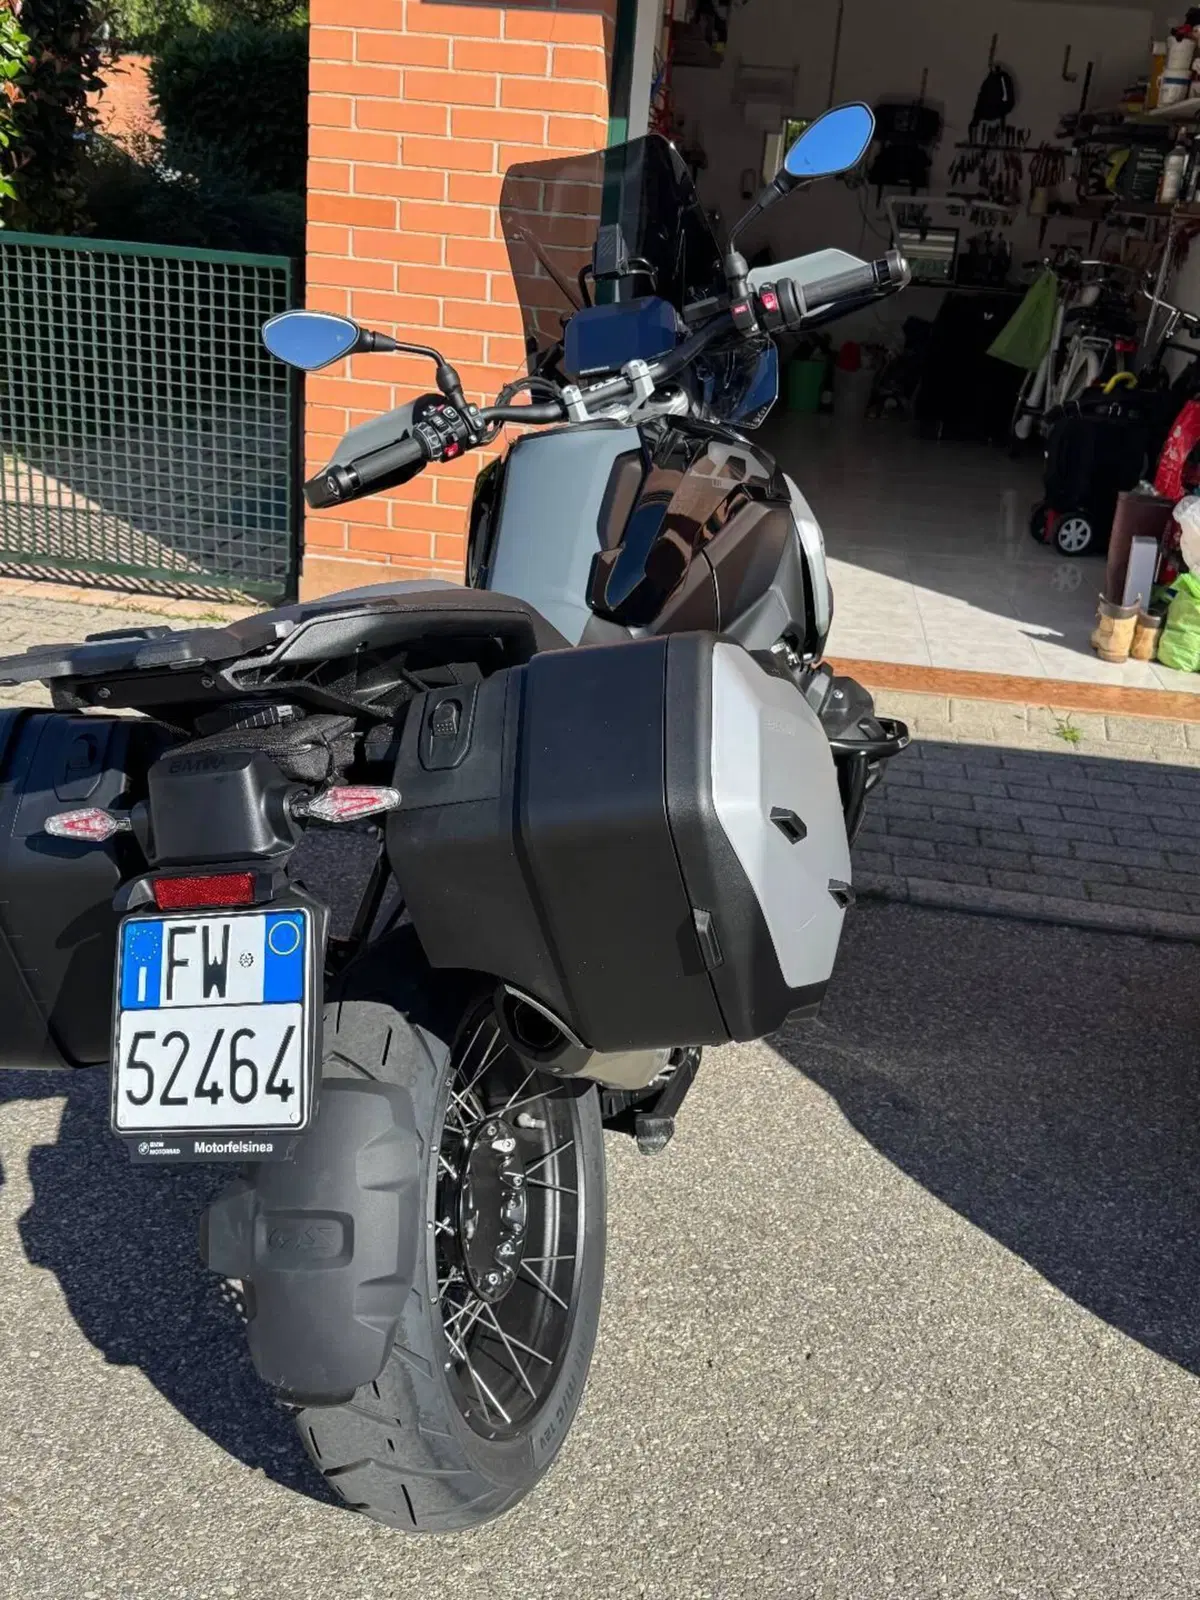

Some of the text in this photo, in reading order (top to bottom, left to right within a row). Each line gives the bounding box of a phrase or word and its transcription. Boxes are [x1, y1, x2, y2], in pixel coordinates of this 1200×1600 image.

[136, 965, 147, 1003] I
[165, 923, 231, 1001] FW
[125, 1025, 296, 1106] 52464
[194, 1140, 274, 1154] Motorfelsinea
